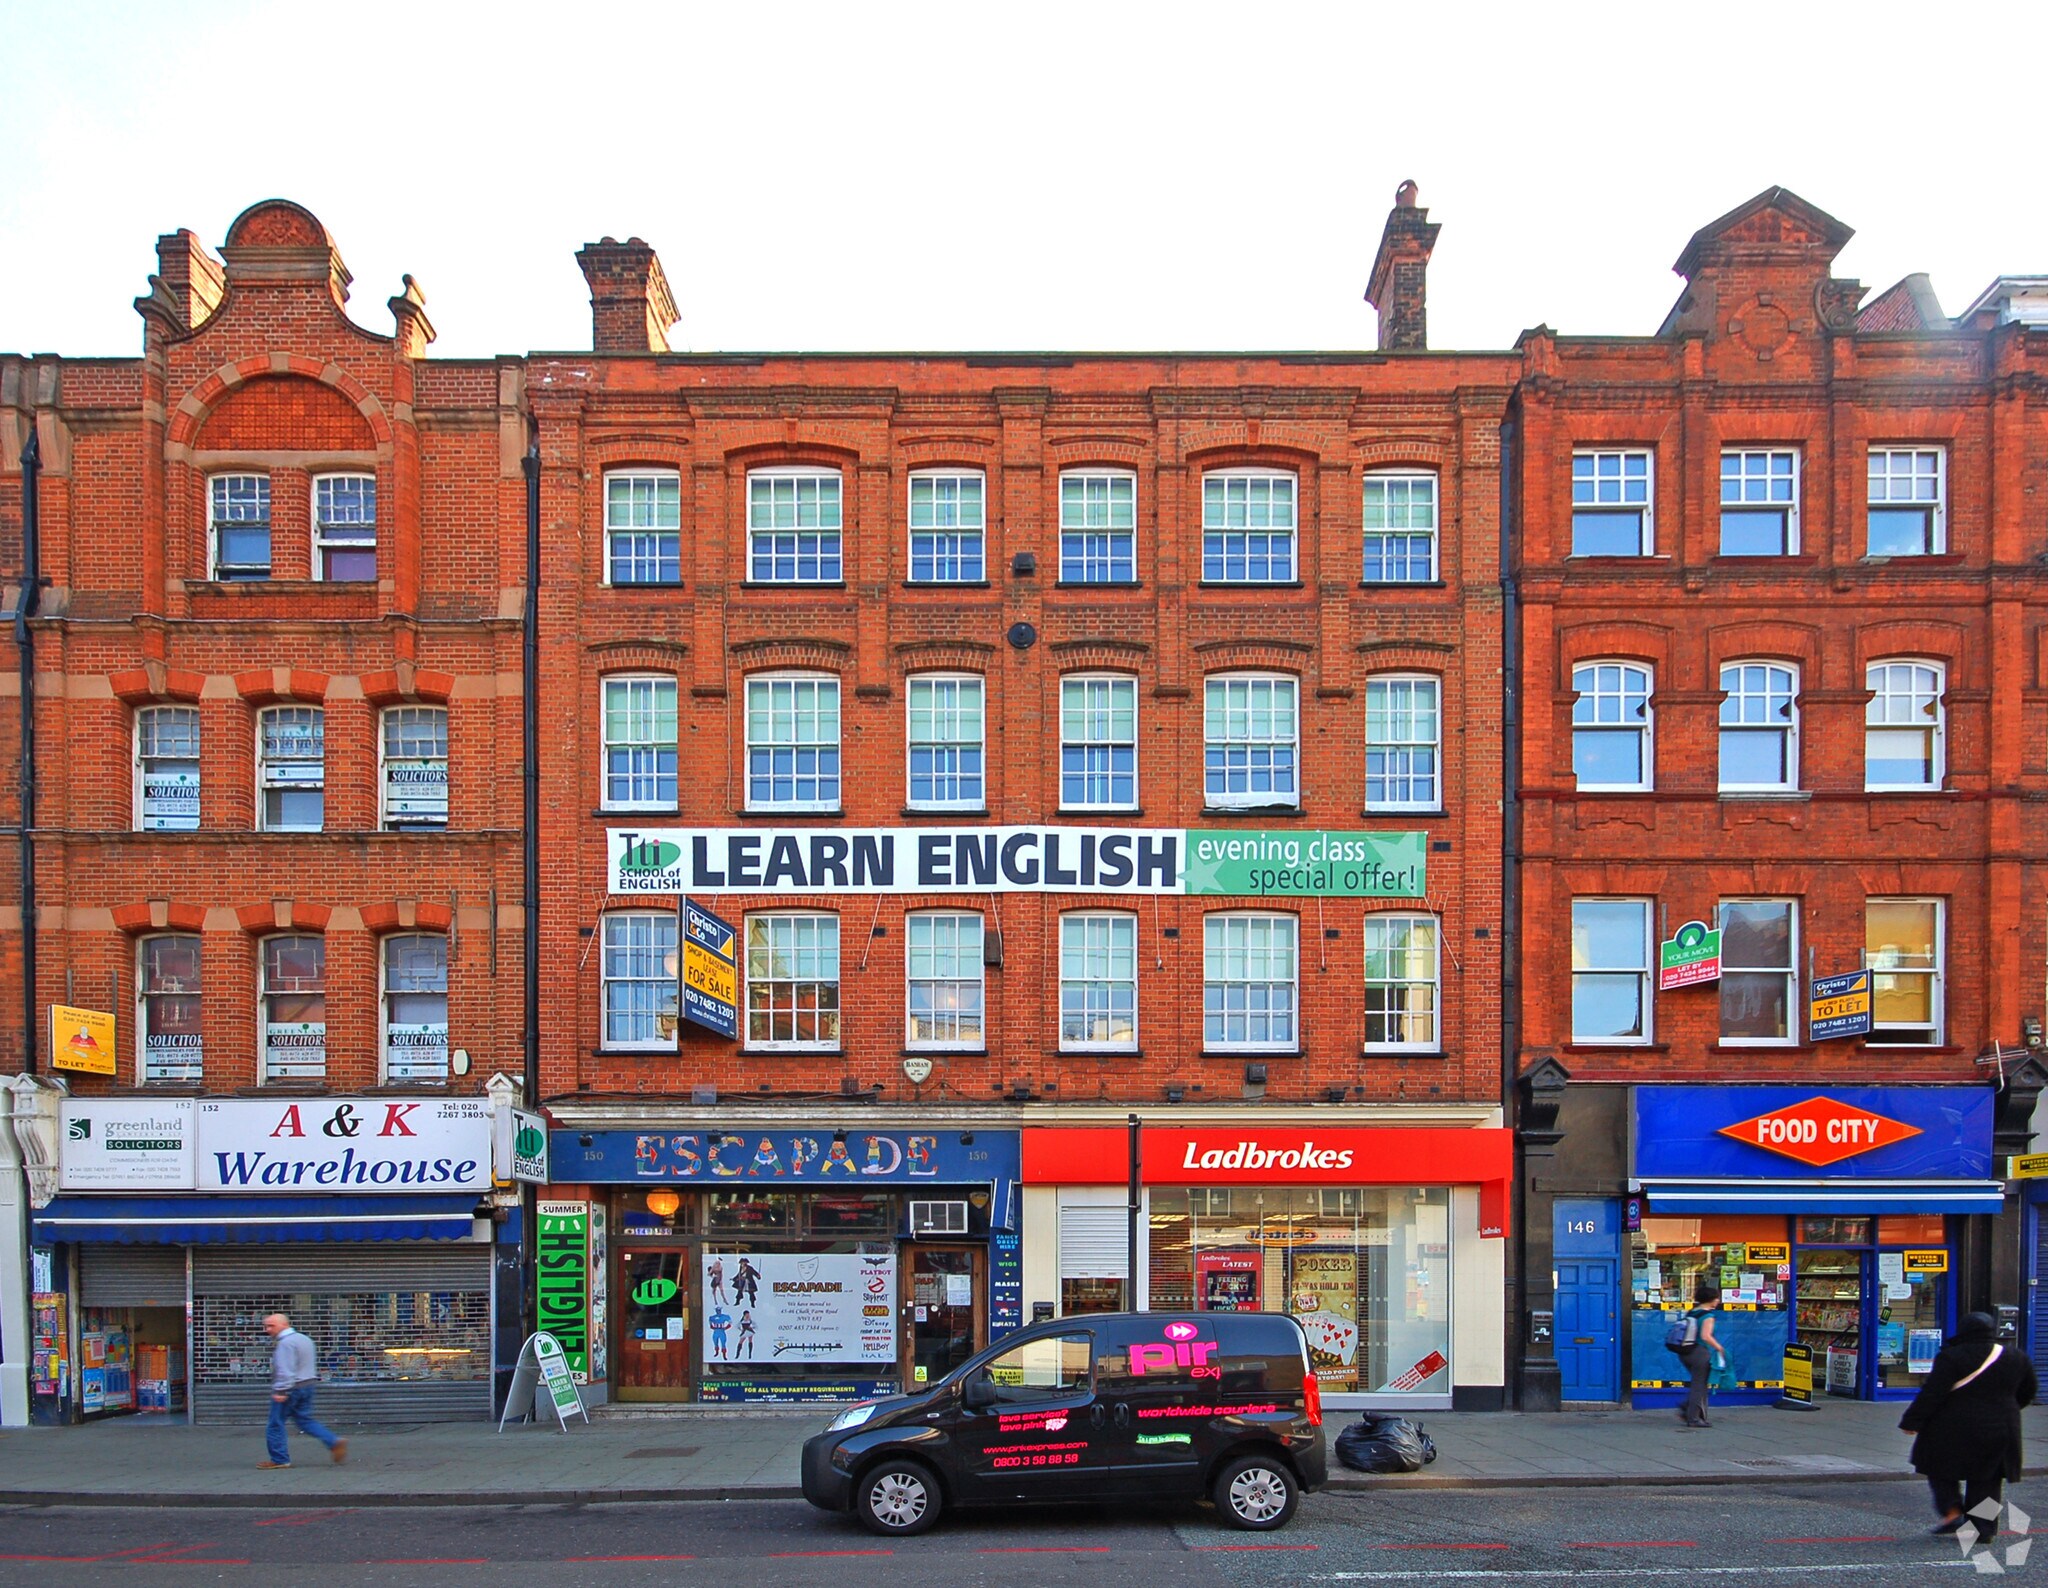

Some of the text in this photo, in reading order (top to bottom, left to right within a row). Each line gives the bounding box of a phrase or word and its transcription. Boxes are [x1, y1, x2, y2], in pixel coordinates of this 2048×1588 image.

[391, 771, 448, 782] SOLICITORS
[1198, 833, 1365, 867] evening class
[692, 833, 1177, 887] LEARN ENGLISH
[619, 868, 668, 878] SCHOOL
[1249, 862, 1415, 895] special offer!
[619, 879, 681, 890] ENGLISH
[689, 911, 718, 937] Christo
[1668, 952, 1690, 961] YOUR
[1692, 946, 1714, 956] MOVE
[703, 963, 718, 978] LEASE
[708, 957, 733, 975] BASEMENT
[688, 966, 732, 1000] FOR SALE
[1816, 981, 1847, 991] Christo
[686, 989, 734, 1020] 020 7482 1203
[1816, 1000, 1862, 1017] TO LET
[1828, 1018, 1846, 1027] 7482
[1848, 1015, 1866, 1024] 1203
[392, 1035, 448, 1046] SOLICITORS
[270, 1103, 421, 1138] A & K
[461, 1111, 485, 1119] 3805
[105, 1118, 182, 1137] greenland
[1757, 1118, 1879, 1143] FOOD CITY
[107, 1141, 181, 1149] SOLICITORS
[584, 1151, 604, 1161] 150
[635, 1136, 938, 1176] ESCAPADE
[969, 1151, 988, 1161] 150
[1183, 1142, 1354, 1169] Ladbrokes
[213, 1147, 478, 1185] Warehouse
[515, 1162, 545, 1178] ENGLISH
[542, 1205, 583, 1214] SUMMER
[1567, 1221, 1595, 1233] 146
[1296, 1257, 1352, 1272] POKER
[540, 1233, 585, 1353] ENGLISH
[773, 1282, 843, 1293] ESCAPADE
[1319, 1282, 1339, 1291] HOLD
[999, 1409, 1069, 1423] love service?
[1138, 1403, 1276, 1419] worldwide couriers
[1000, 1421, 1045, 1432] love pink
[983, 1442, 1088, 1454] www.pinkexpress.com
[993, 1457, 1021, 1467] 0800
[1023, 1456, 1030, 1466] 3
